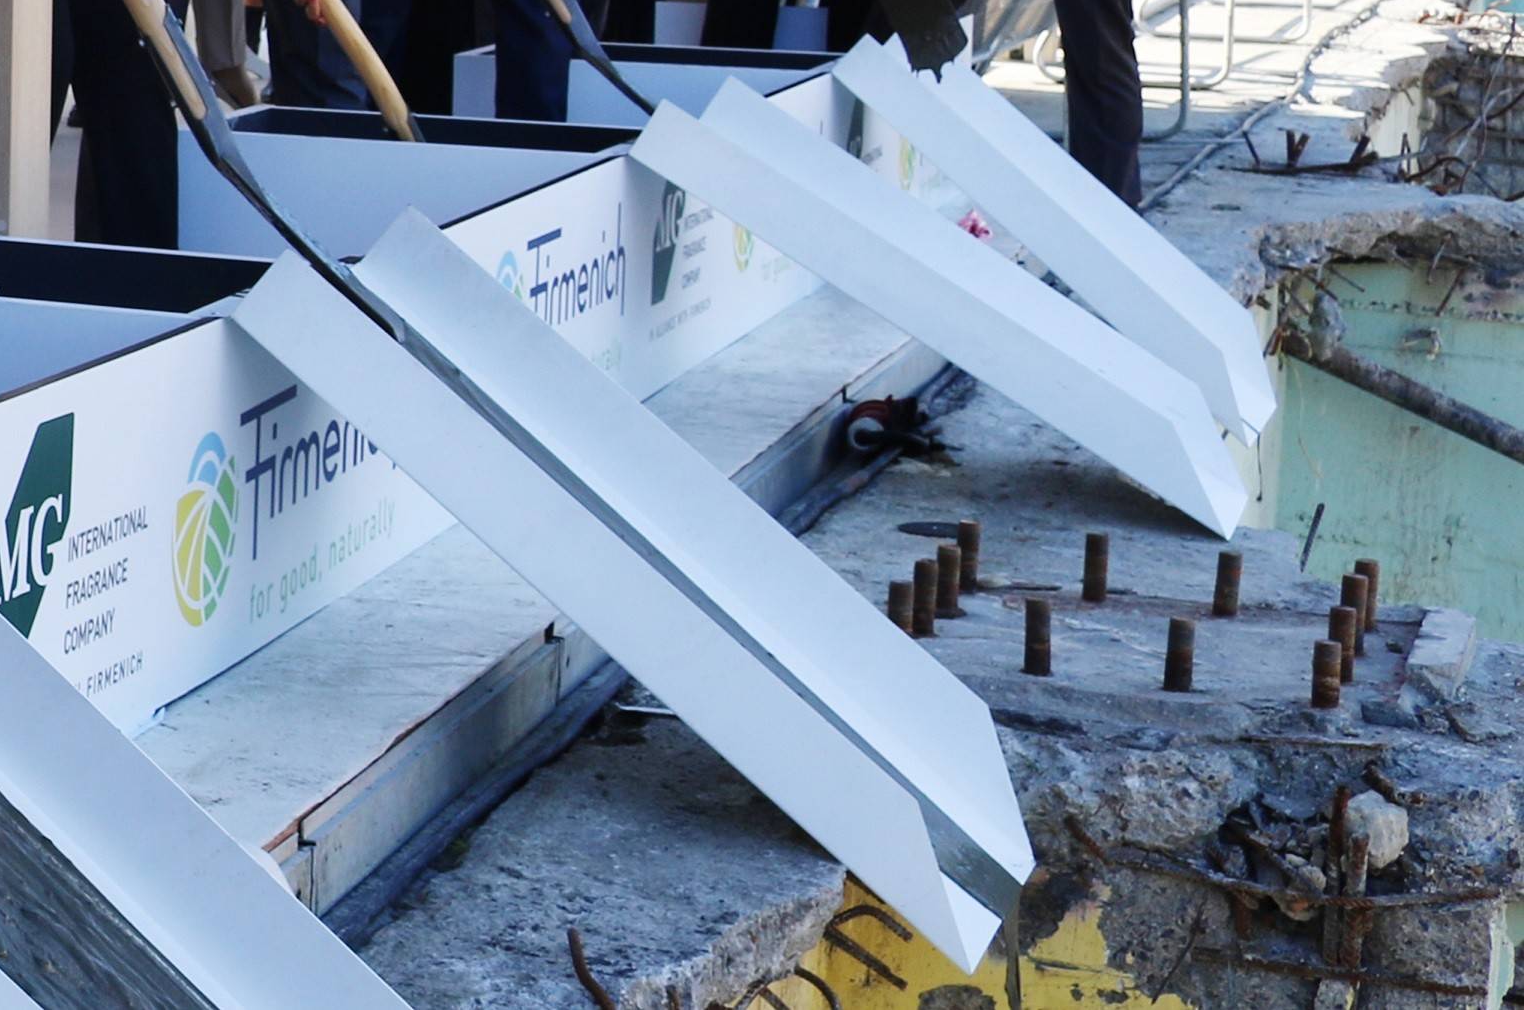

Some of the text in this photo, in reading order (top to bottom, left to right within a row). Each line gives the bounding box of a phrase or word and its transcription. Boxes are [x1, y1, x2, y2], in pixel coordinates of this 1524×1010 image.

[527, 201, 626, 326] Firmenich
[240, 384, 396, 561] Firmeni
[68, 505, 149, 563] INTERNATIONAL
[250, 582, 274, 624] for
[328, 496, 396, 570] naturally
[65, 558, 129, 610] FRAGRANCE
[63, 607, 116, 655] COMPANY
[85, 649, 144, 698] FIRMENICH
